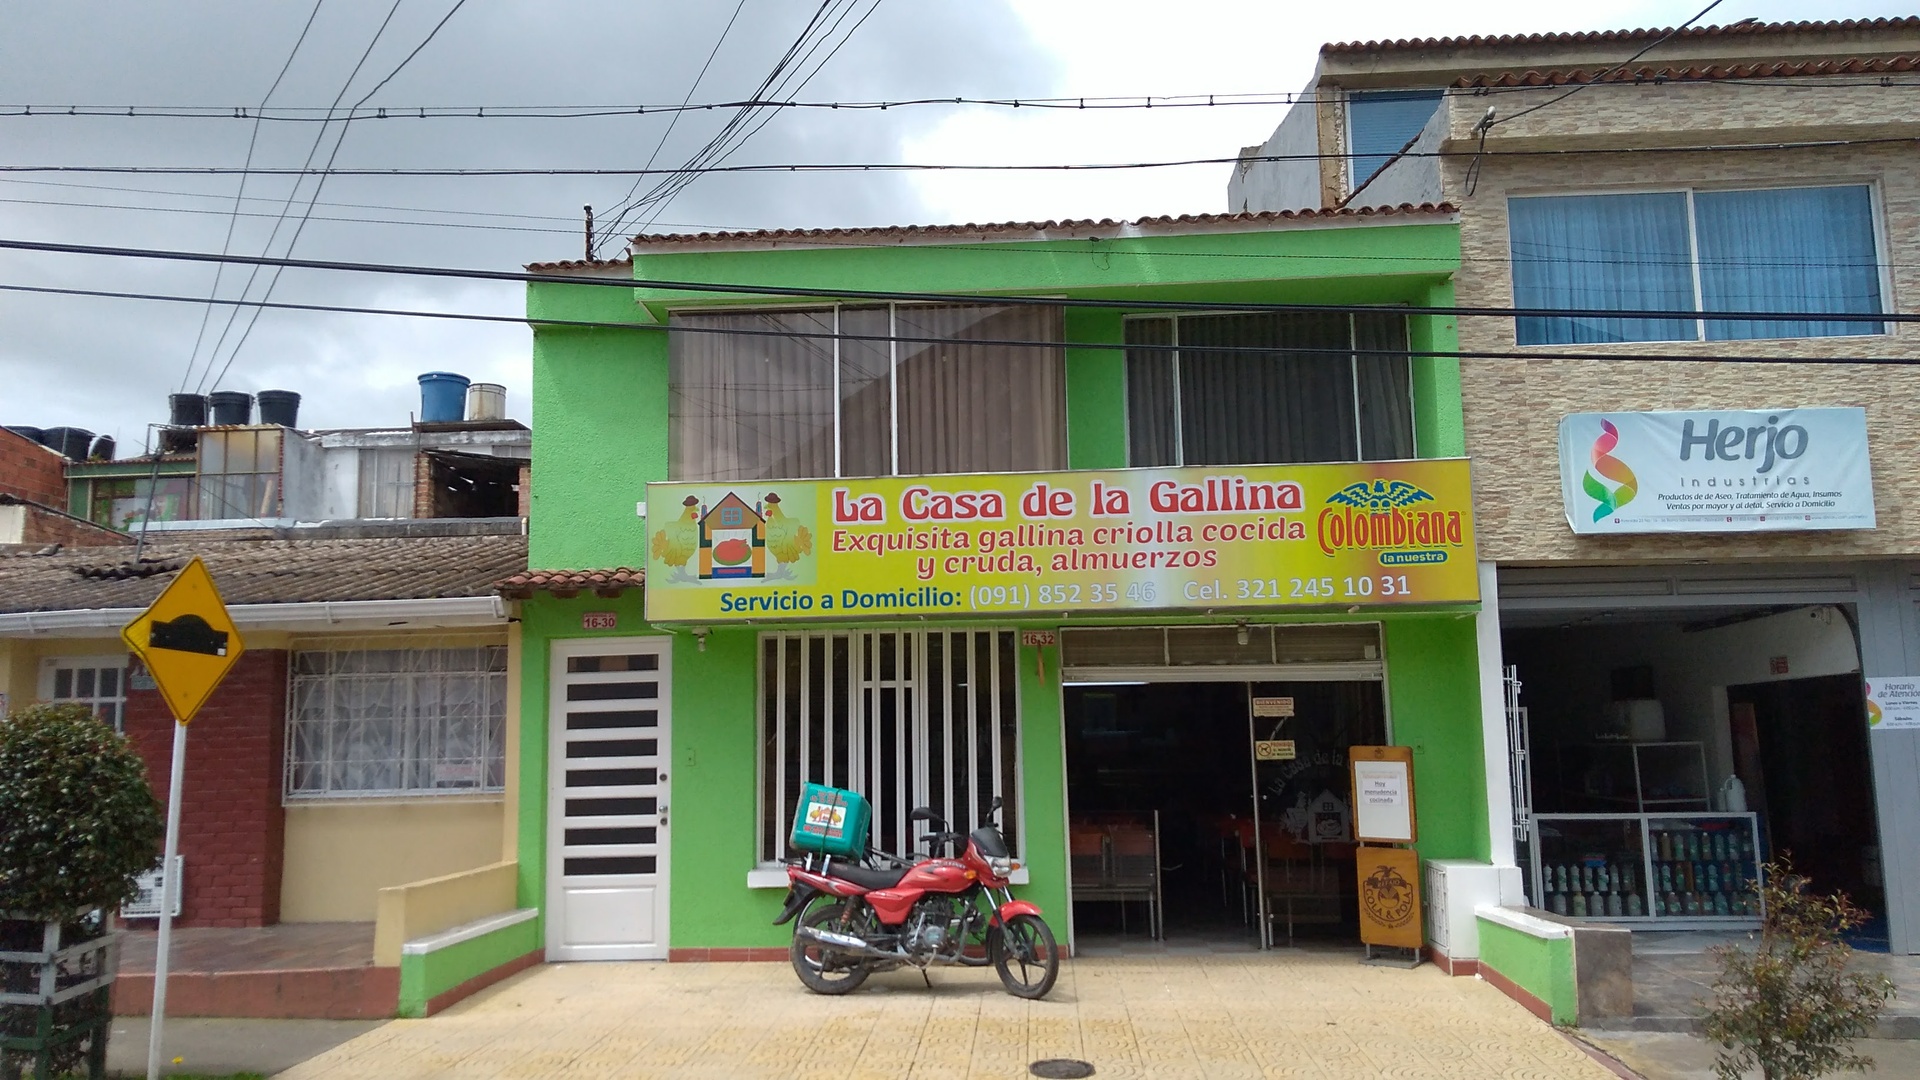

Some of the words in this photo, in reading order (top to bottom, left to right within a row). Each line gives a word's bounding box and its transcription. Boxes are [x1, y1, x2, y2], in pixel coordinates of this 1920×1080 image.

[1679, 415, 1809, 474] Herjo
[1680, 475, 1811, 488] Industrias
[1790, 491, 1811, 499] Agua,
[834, 489, 884, 522] La
[902, 487, 1004, 521] Casa
[1022, 484, 1073, 518] de
[1093, 481, 1130, 515] la
[1150, 477, 1304, 514] Gallina
[1692, 503, 1704, 511] por
[1706, 503, 1728, 511] mayor
[1801, 500, 1835, 508] Domicilio
[833, 527, 970, 556] Exquisita
[978, 521, 1085, 553] gallina
[1092, 519, 1193, 546] criolla
[1202, 515, 1306, 543] cocida
[1318, 506, 1462, 555] Colombiana
[917, 556, 936, 580] y
[943, 549, 1042, 577] cruda,
[1051, 547, 1217, 572] almuerzos
[1383, 554, 1395, 563] la
[1397, 553, 1444, 562] nuestra
[720, 588, 814, 613] Servicio
[820, 594, 834, 609] a
[842, 586, 963, 609] Domicilio:
[969, 584, 1031, 609] (091)
[1038, 583, 1084, 604] 852
[1090, 583, 1118, 604] 35
[1126, 580, 1156, 602] 46
[1183, 579, 1228, 601] Cel.
[1236, 578, 1281, 600] 321
[1289, 577, 1334, 598] 245
[1343, 575, 1373, 597] 10
[1381, 574, 1411, 596] 31
[584, 617, 615, 628] 16-30
[1366, 888, 1383, 917] COLA
[1386, 910, 1395, 920] &
[1395, 891, 1411, 917] POLA
